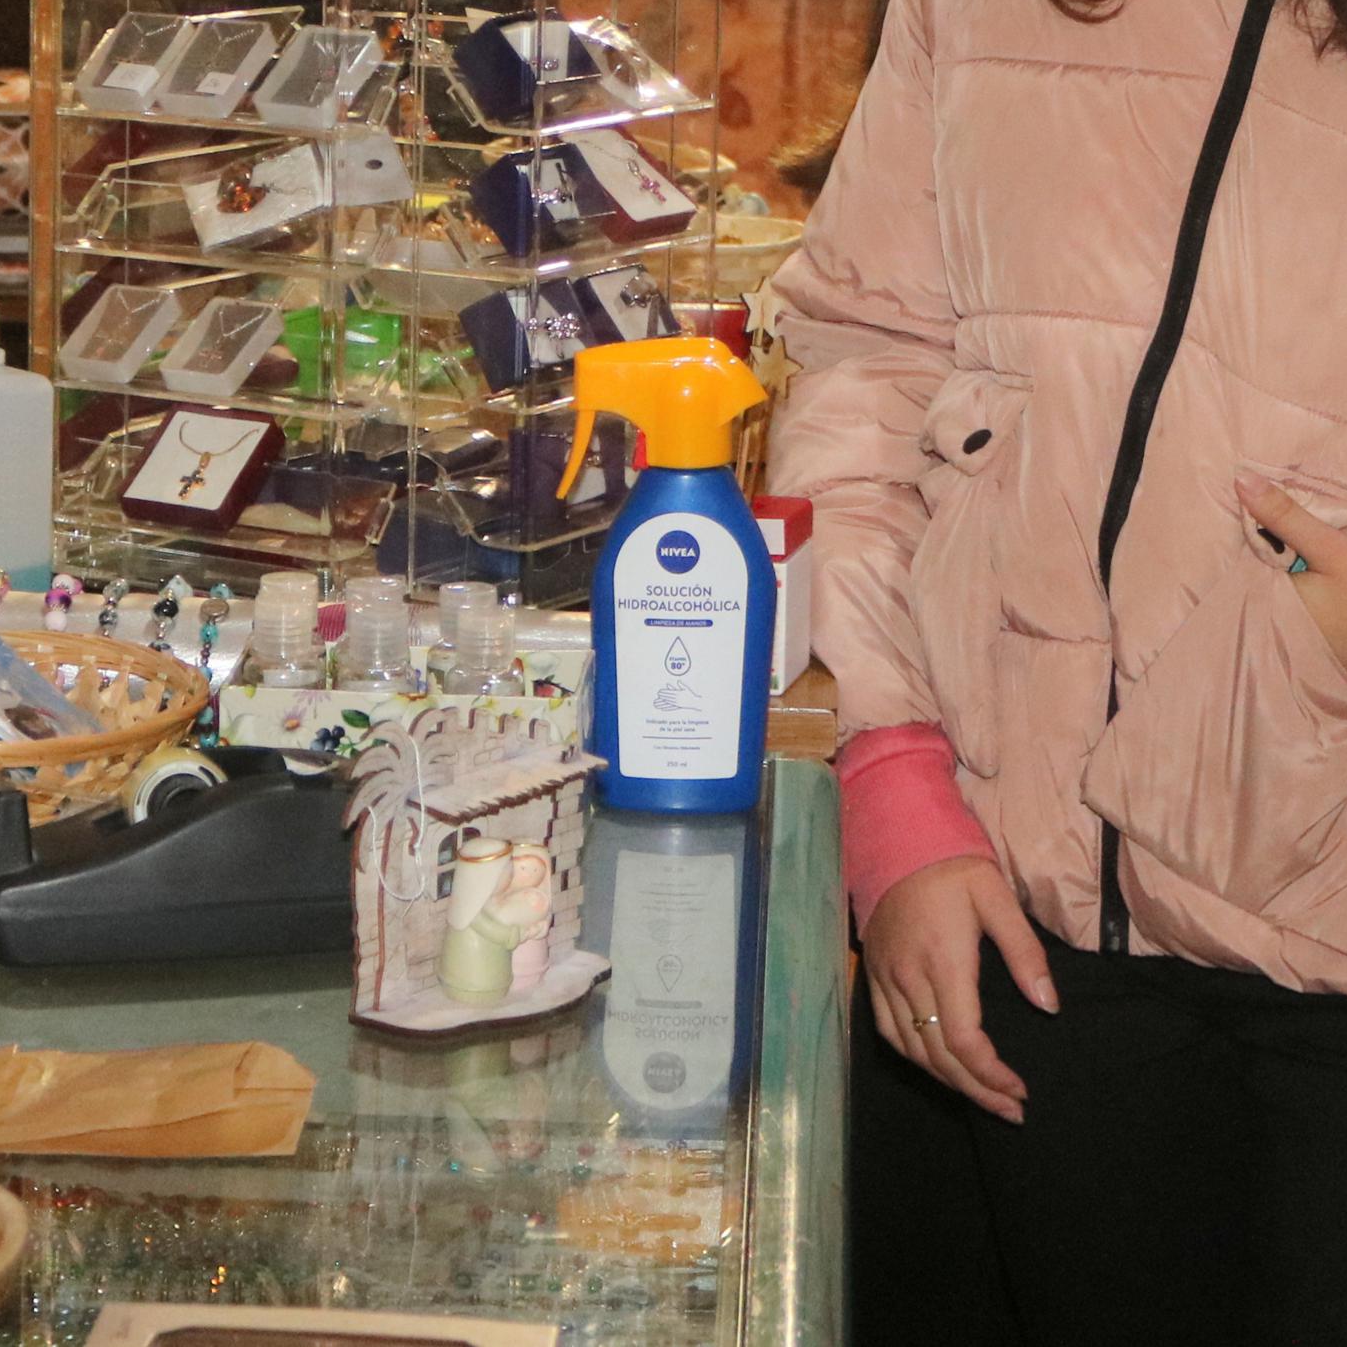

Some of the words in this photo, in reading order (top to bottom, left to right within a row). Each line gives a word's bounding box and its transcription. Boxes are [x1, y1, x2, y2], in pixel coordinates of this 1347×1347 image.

[660, 548, 696, 557] NIVEA
[646, 584, 712, 597] SOLUCIÓN
[618, 598, 740, 612] HIDROALCOHÓLICA
